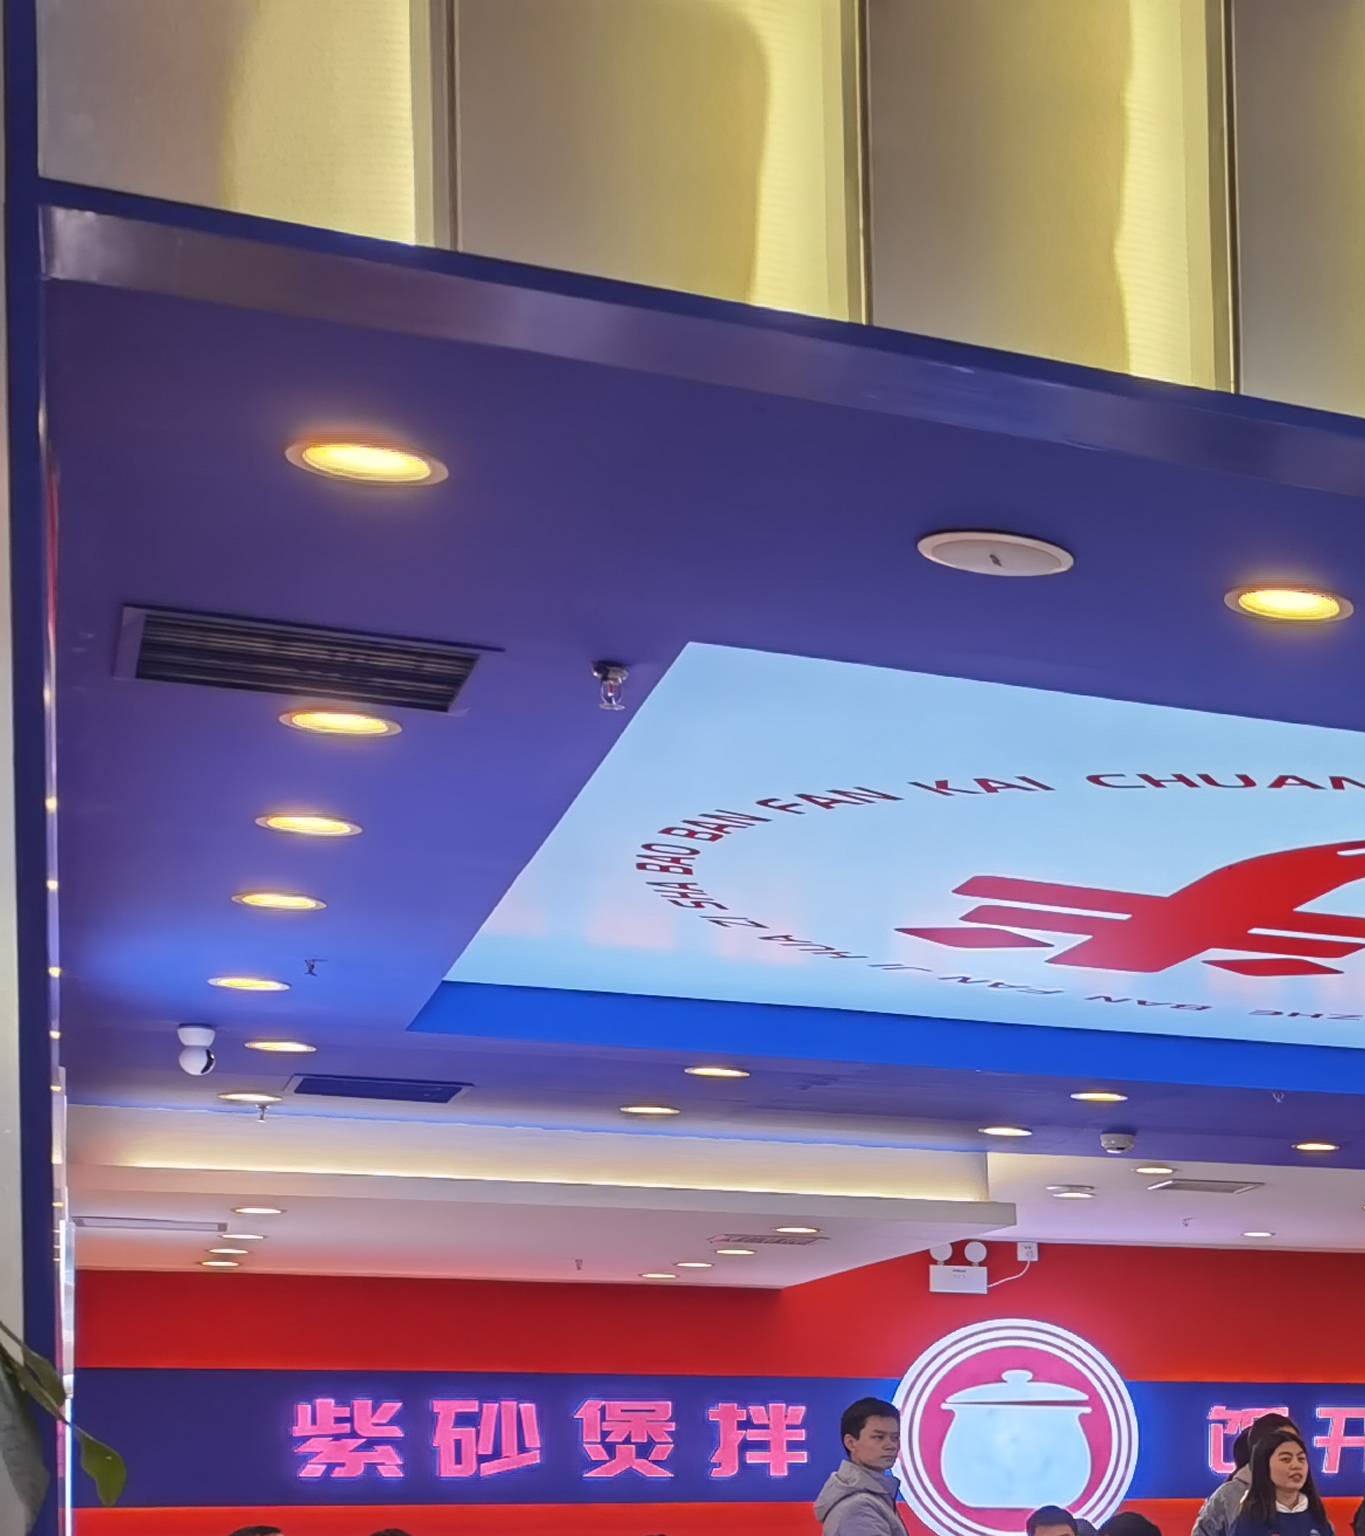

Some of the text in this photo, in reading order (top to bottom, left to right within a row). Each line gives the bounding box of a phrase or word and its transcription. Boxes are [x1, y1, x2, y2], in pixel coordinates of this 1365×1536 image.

[755, 785, 903, 815] FAN
[908, 776, 1055, 796] KAI
[659, 809, 772, 843] BAN
[636, 842, 700, 876] BAO
[293, 1398, 809, 1479] 紫砂煲拌
